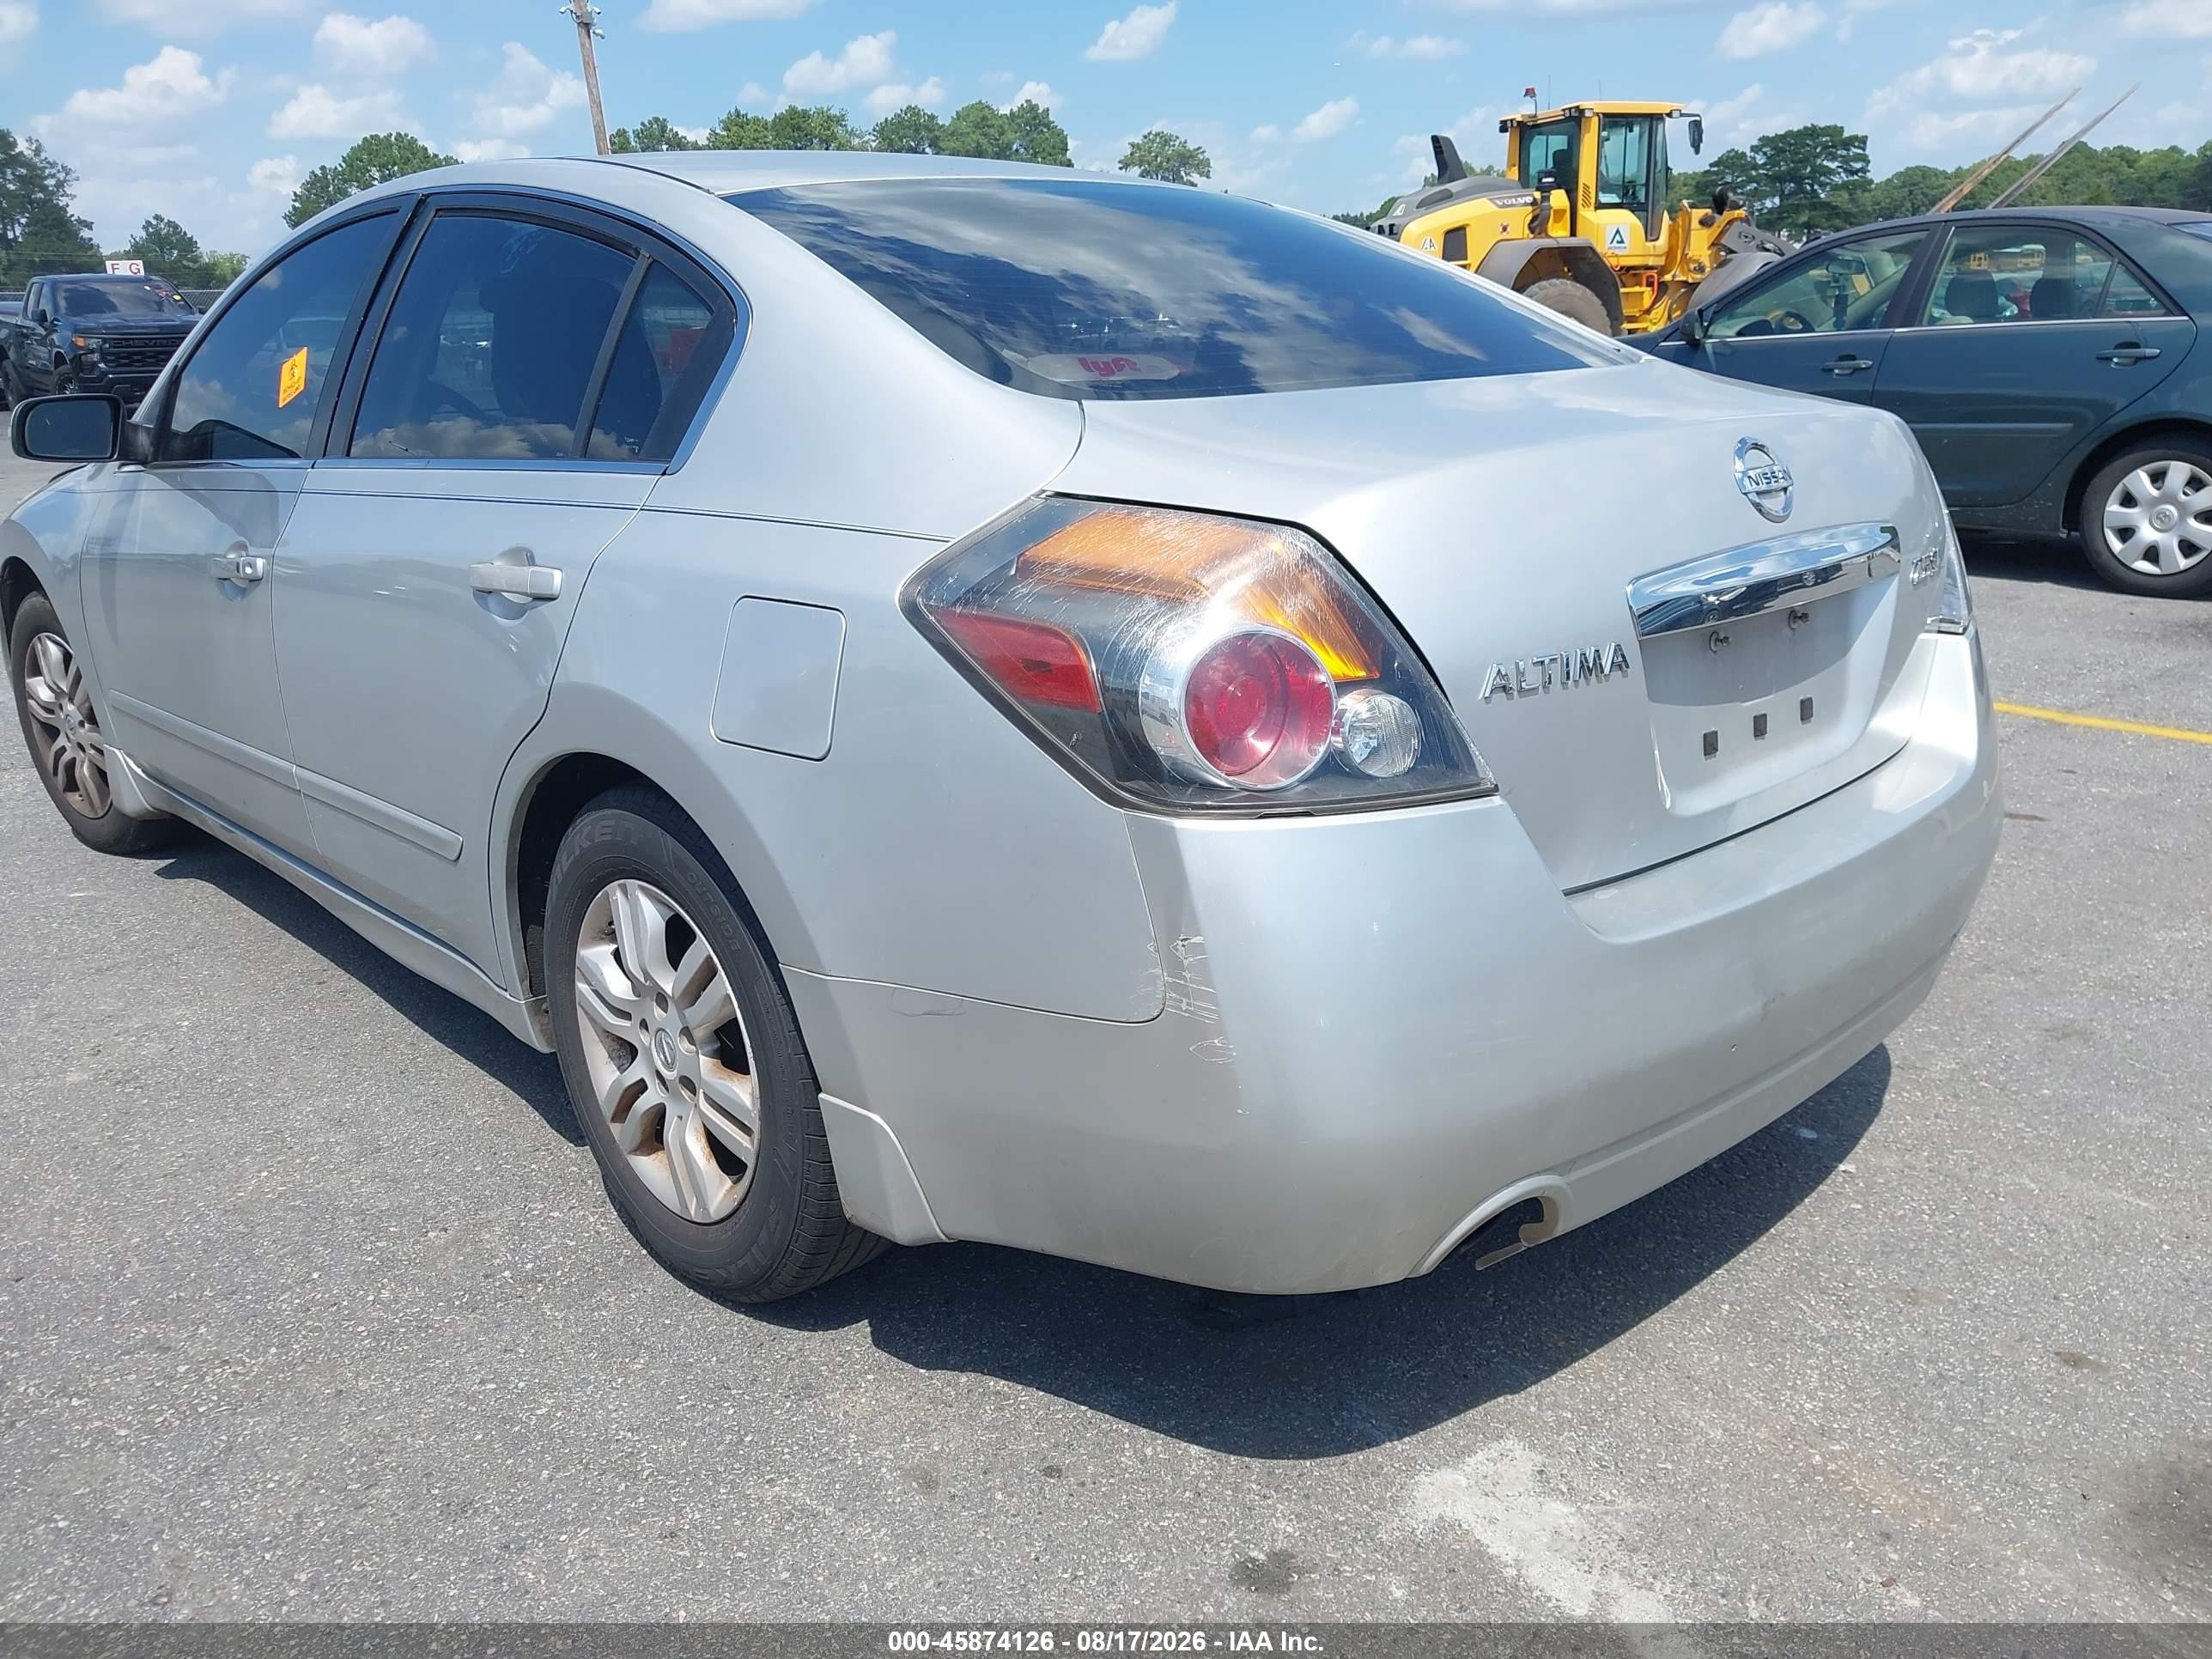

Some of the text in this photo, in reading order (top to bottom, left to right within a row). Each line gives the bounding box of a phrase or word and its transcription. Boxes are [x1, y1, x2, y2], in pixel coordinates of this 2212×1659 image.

[1496, 196, 1534, 206] VOLVO
[110, 262, 142, 276] F G
[110, 339, 181, 348] CHEVRO
[1477, 641, 1631, 701] ALTIMA
[687, 872, 742, 951] OUTSIDE
